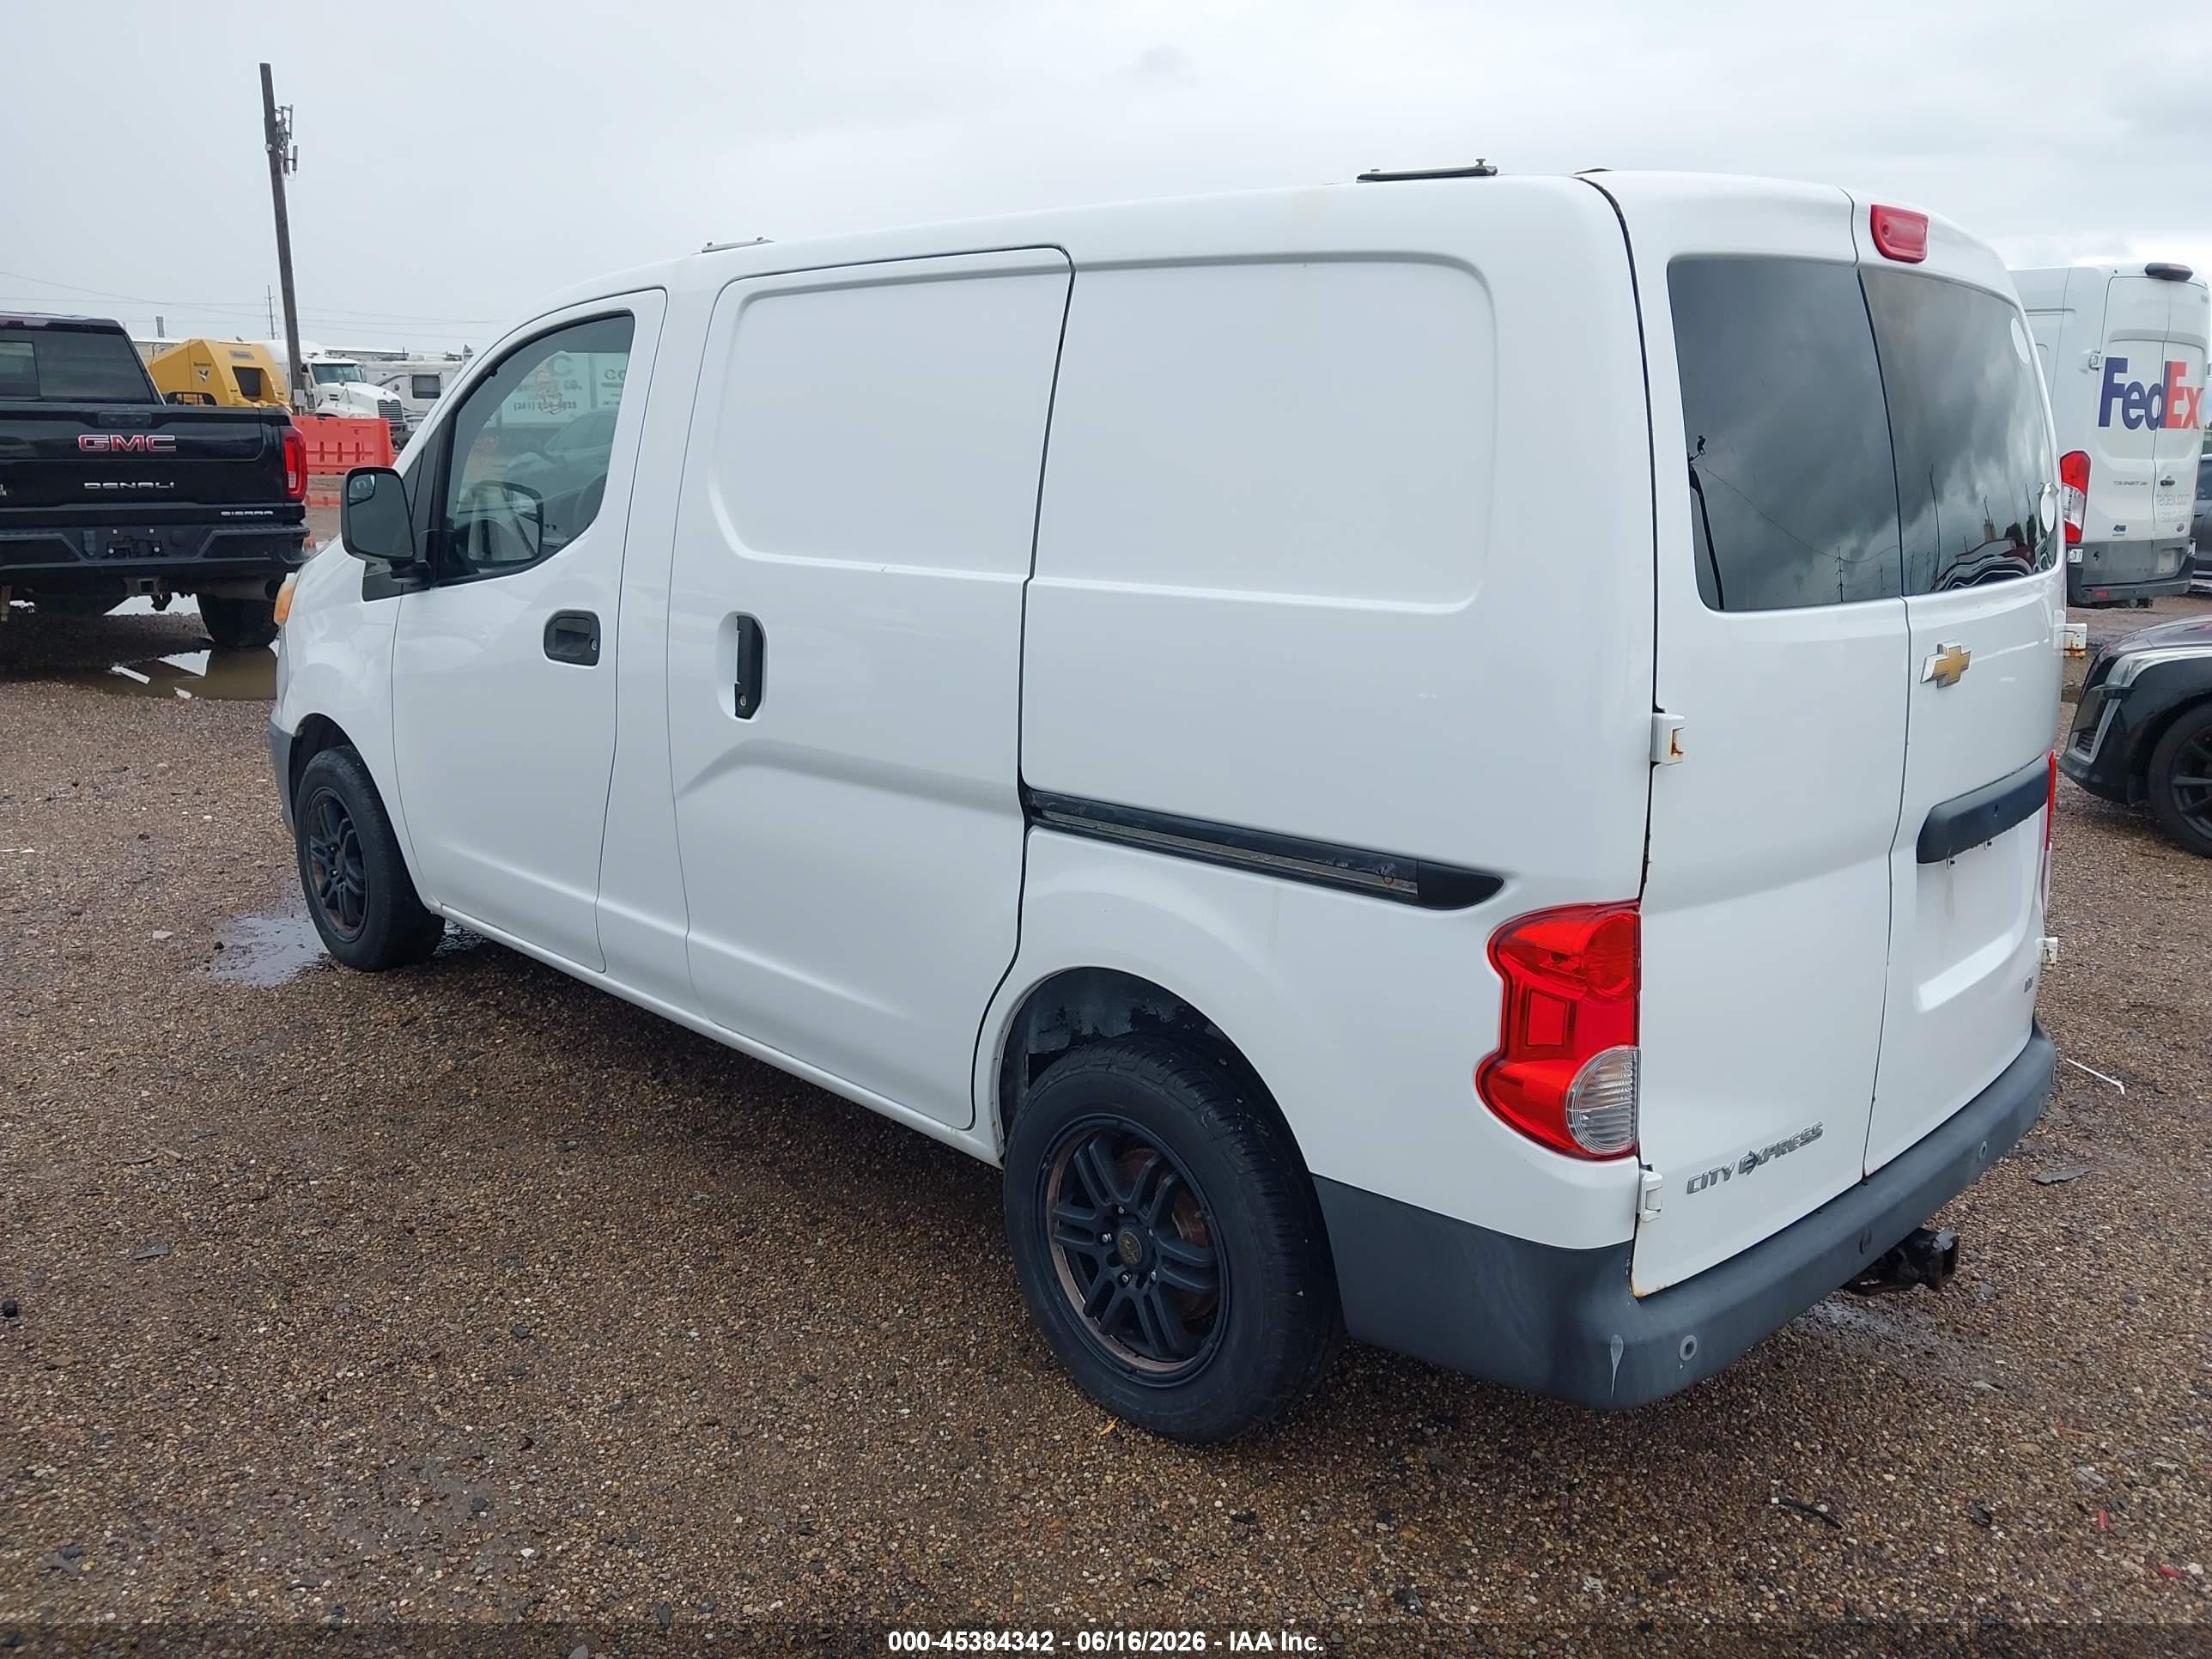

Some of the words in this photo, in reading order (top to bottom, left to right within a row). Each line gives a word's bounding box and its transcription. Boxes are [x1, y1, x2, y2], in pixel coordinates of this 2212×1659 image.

[2098, 356, 2204, 430] FedEx
[78, 434, 177, 453] GMC
[1686, 1161, 1735, 1194] CITY
[1738, 1121, 1824, 1175] EXPRESS
